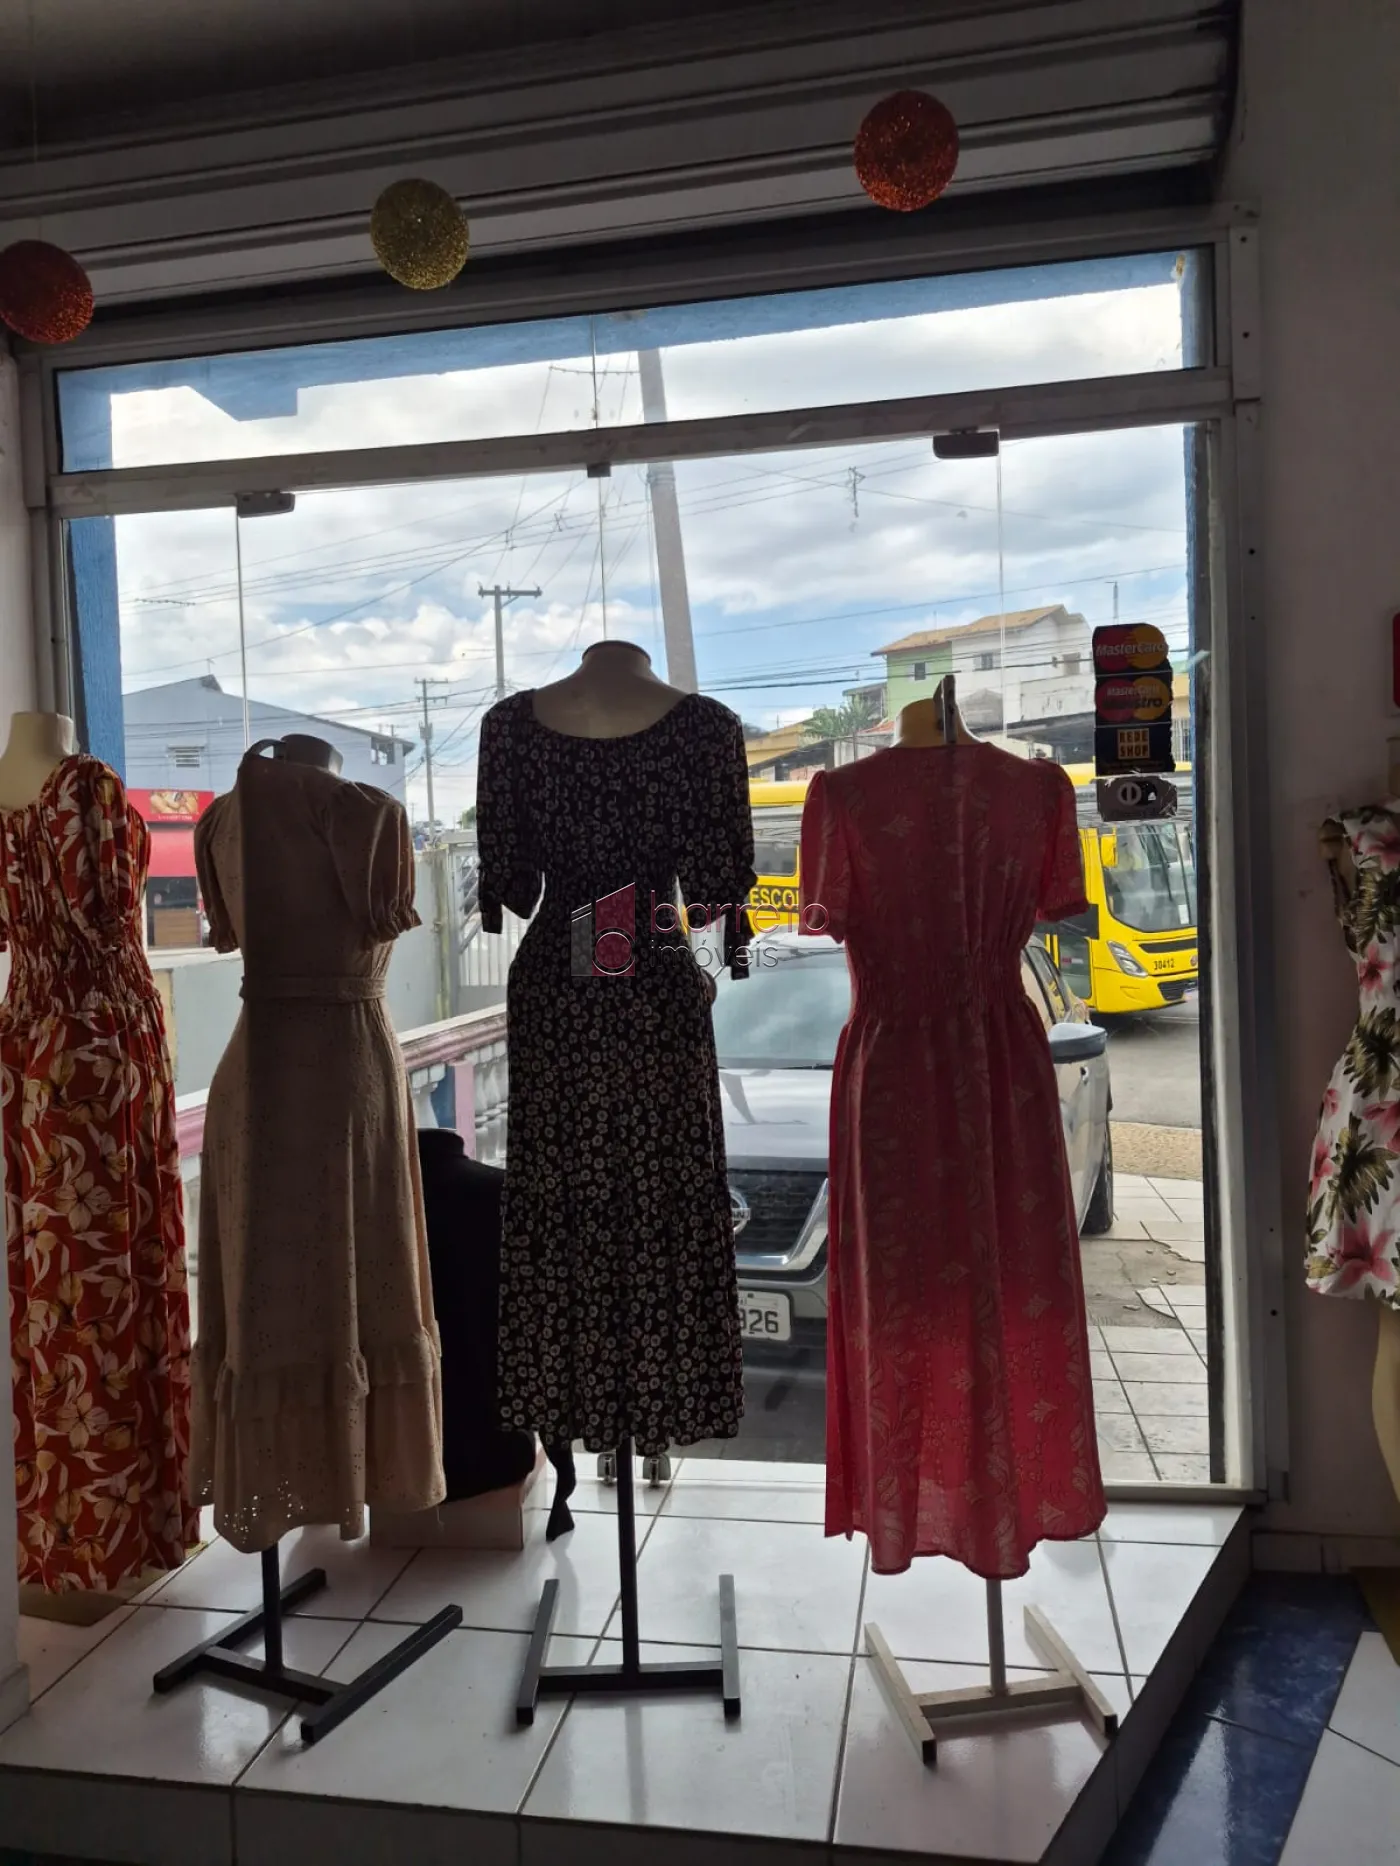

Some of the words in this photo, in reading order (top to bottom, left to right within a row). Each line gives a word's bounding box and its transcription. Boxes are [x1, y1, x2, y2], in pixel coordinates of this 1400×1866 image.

[1119, 731, 1148, 743] REDE
[1119, 744, 1148, 757] SHOP
[1153, 958, 1175, 971] 30412
